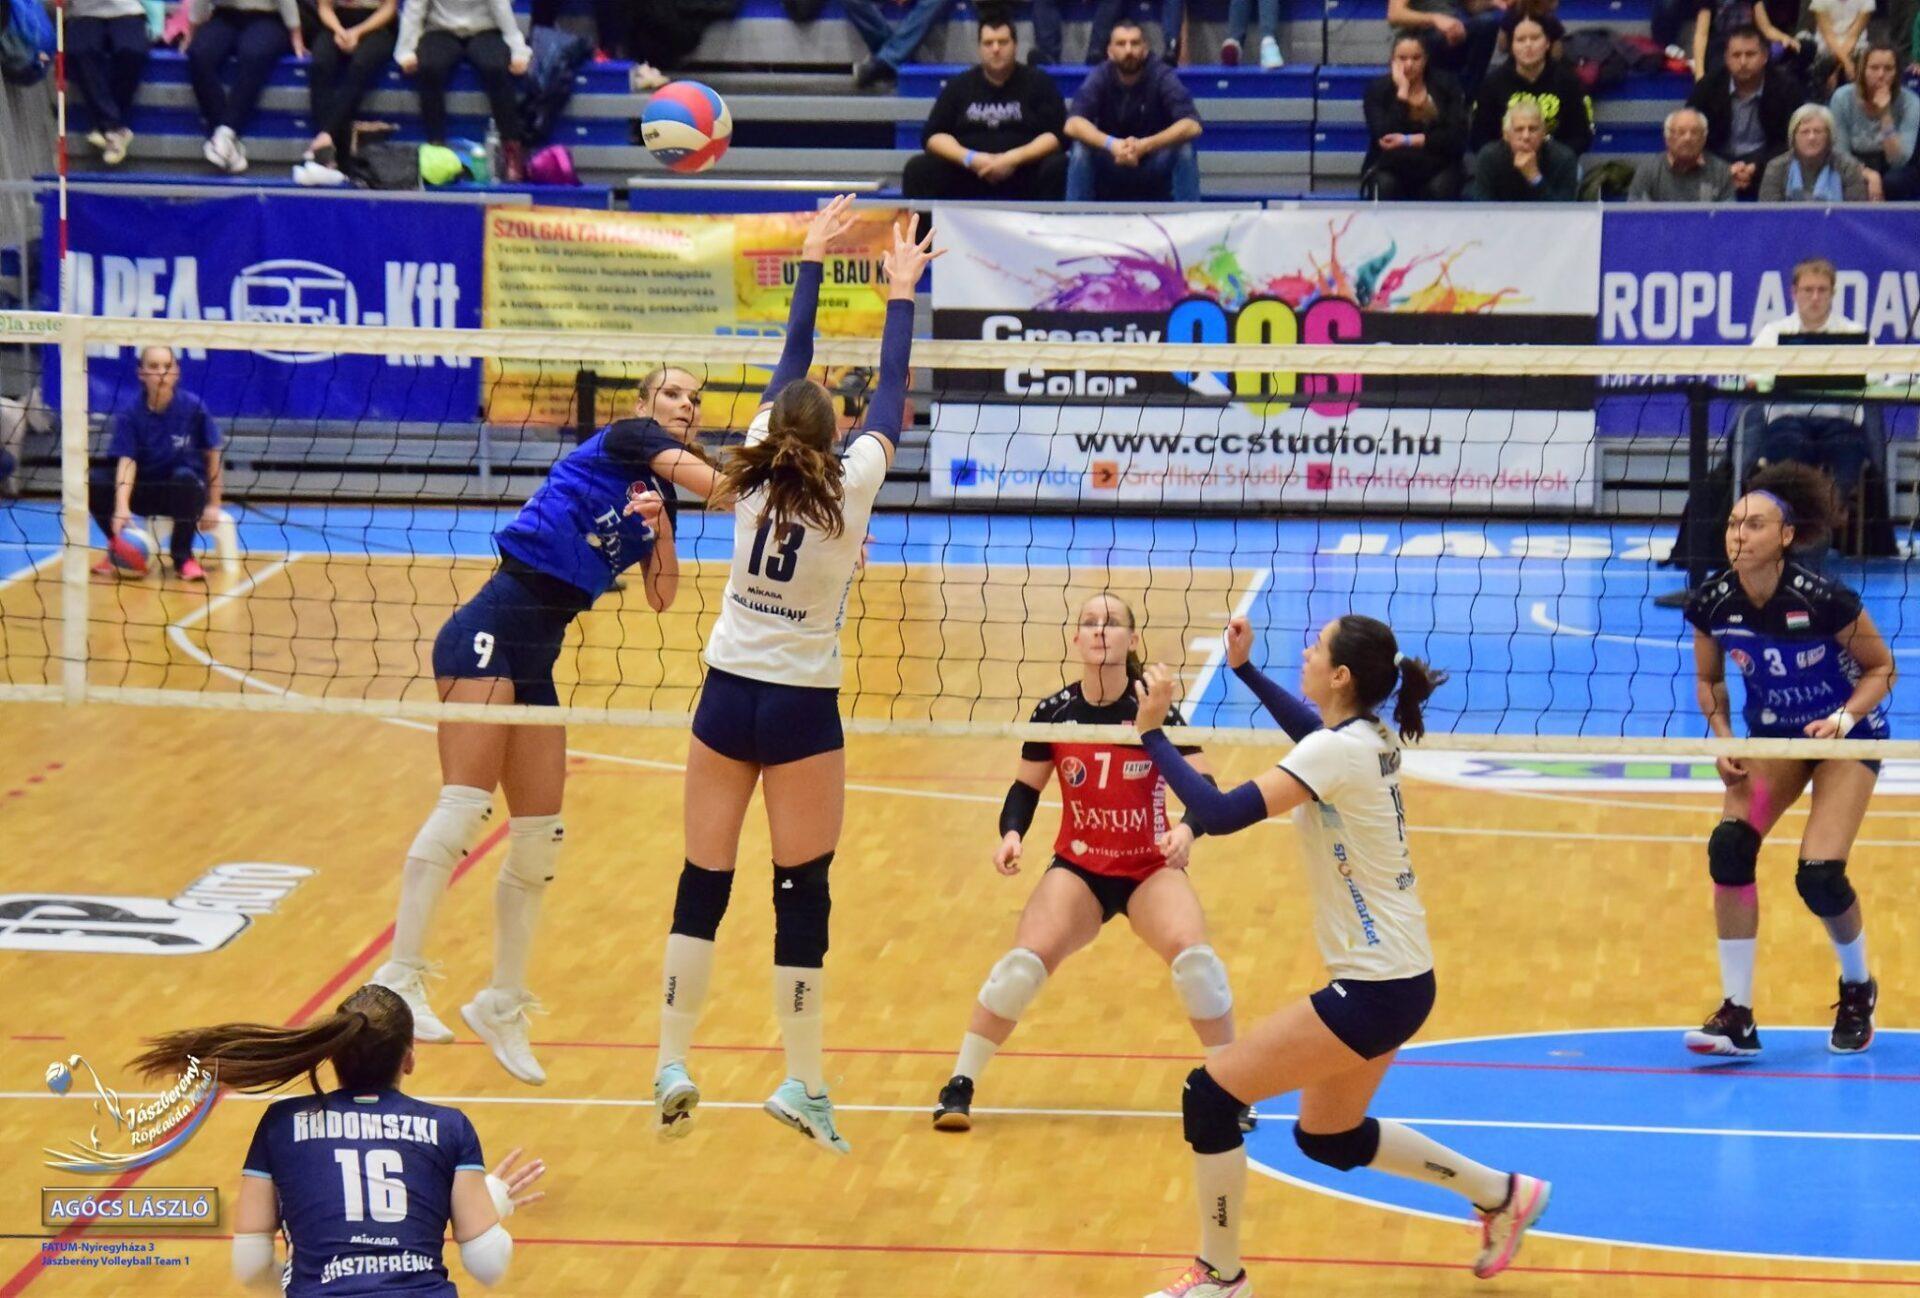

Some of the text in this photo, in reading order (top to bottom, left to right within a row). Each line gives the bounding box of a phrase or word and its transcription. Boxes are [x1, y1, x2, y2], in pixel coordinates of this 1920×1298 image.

[1075, 427, 1441, 456] www.ccstudio.hu
[1339, 465, 1570, 495] Reklámajándékok
[748, 517, 806, 583] 13
[473, 631, 495, 668] 9
[1763, 647, 1788, 676] 3
[1094, 752, 1111, 789] 7
[294, 1110, 438, 1146] RADOMSZKI
[334, 1148, 408, 1223] 16
